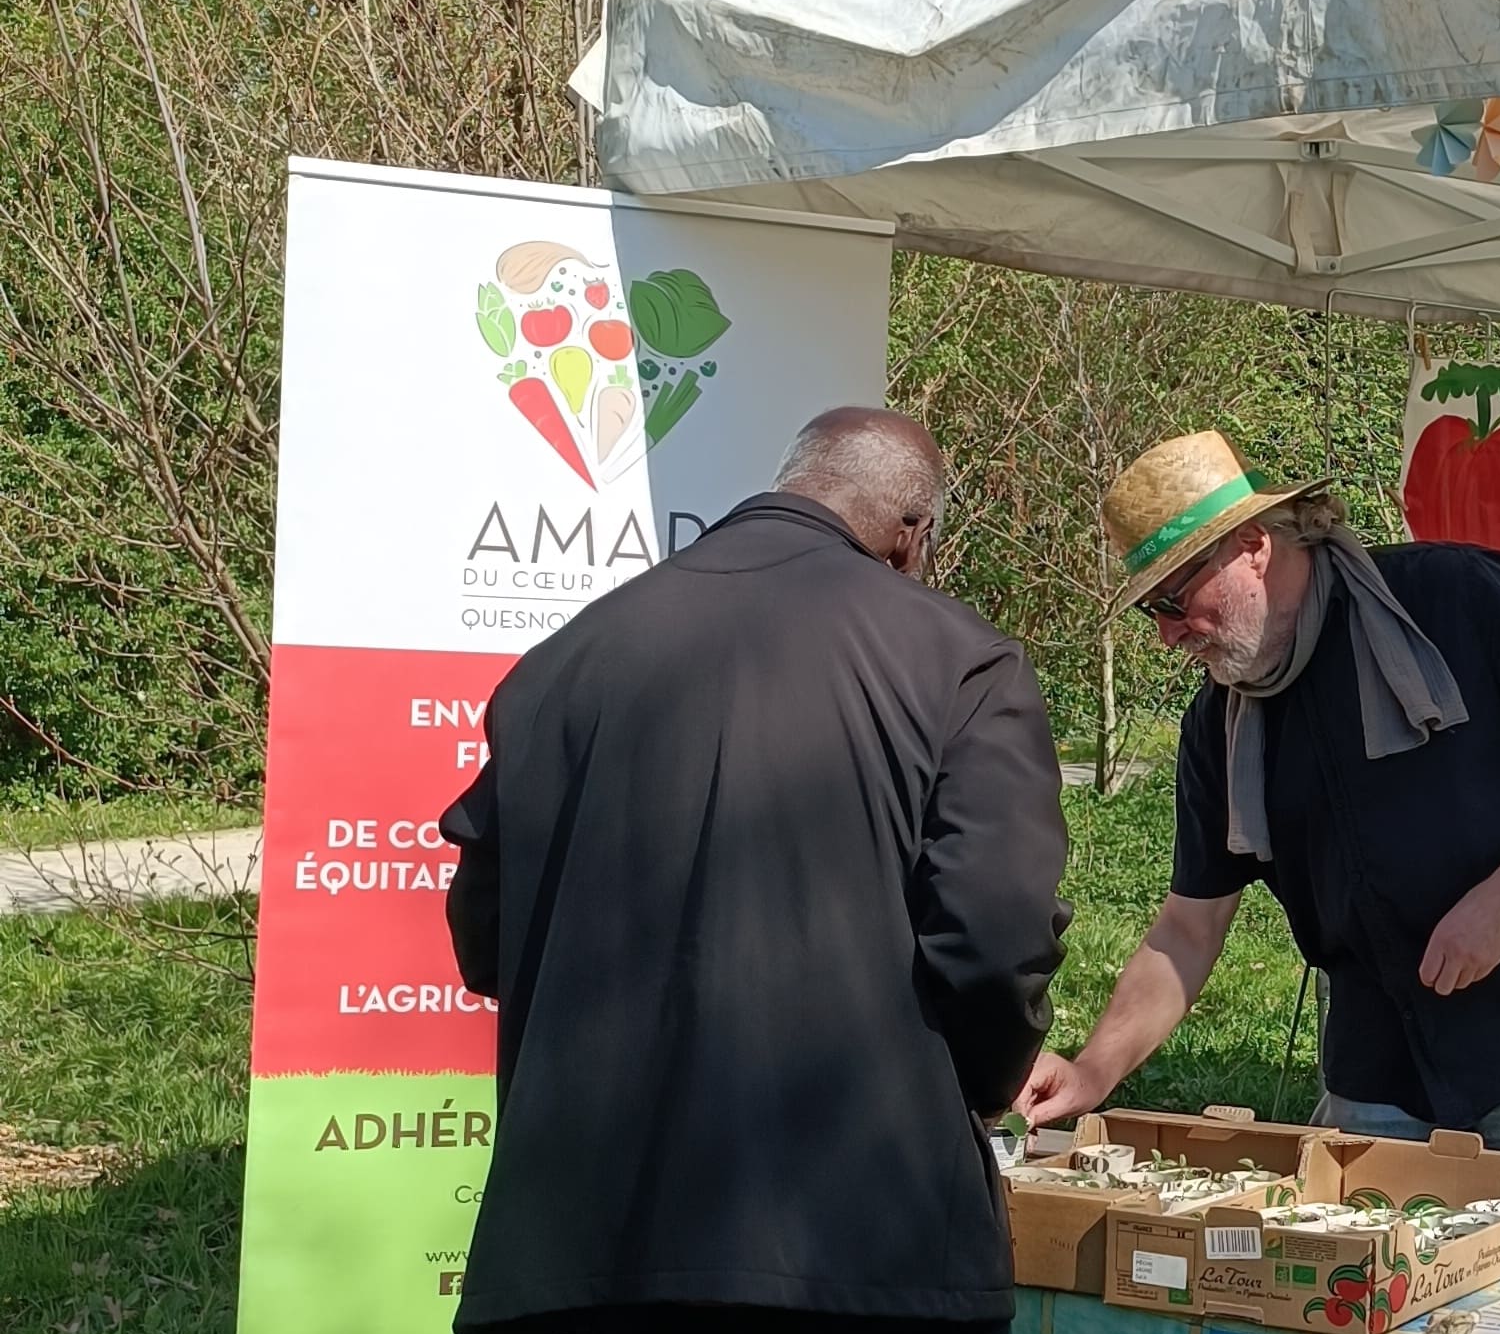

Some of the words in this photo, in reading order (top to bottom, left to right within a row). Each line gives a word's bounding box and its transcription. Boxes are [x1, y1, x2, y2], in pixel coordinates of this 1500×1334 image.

[464, 567, 498, 586] DU
[512, 570, 594, 591] CŒUR
[461, 608, 573, 631] QUESNO
[328, 819, 378, 848] DE
[1199, 1266, 1223, 1284] La
[1225, 1266, 1263, 1289] Tour
[1410, 1273, 1432, 1305] La
[1433, 1260, 1465, 1294] Tour
